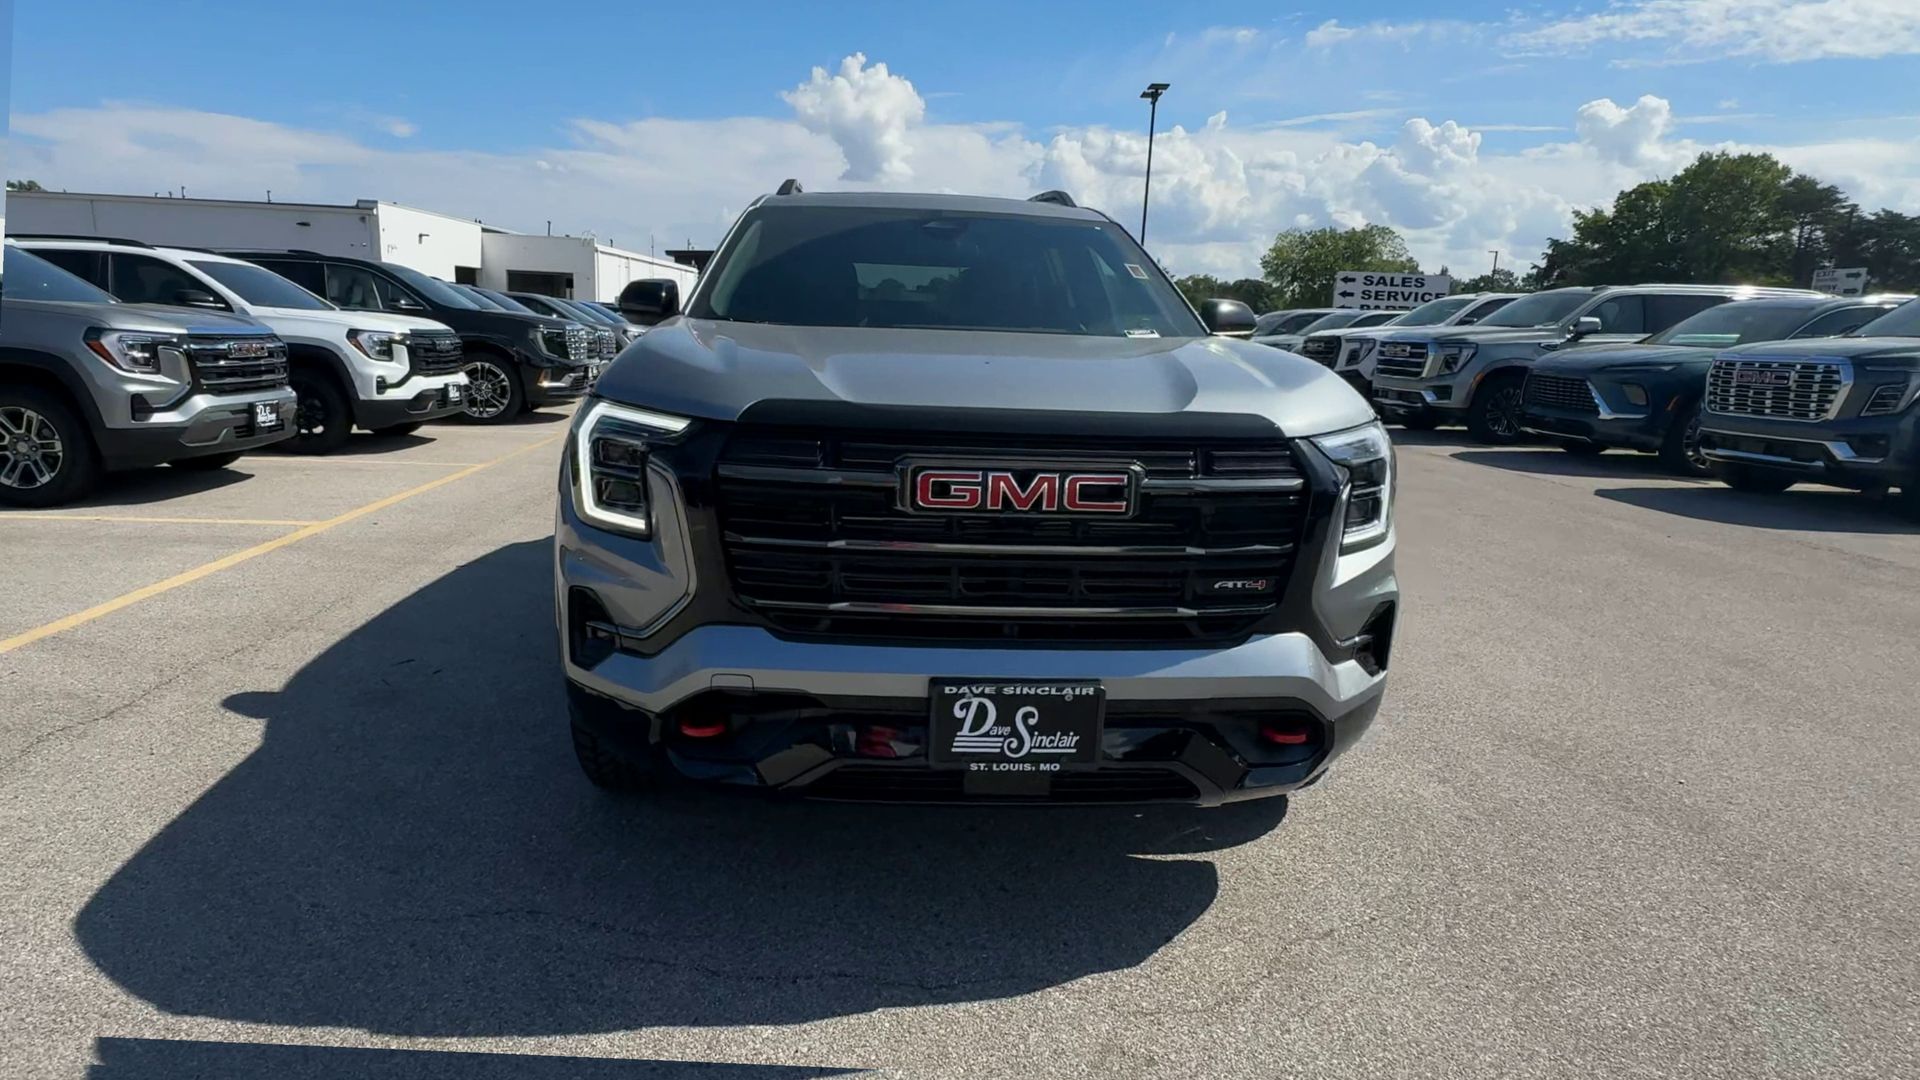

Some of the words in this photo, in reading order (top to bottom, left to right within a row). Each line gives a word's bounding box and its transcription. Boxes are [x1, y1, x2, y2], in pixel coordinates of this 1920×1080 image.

[1363, 275, 1426, 288] SALES
[1737, 371, 1789, 384] GMC
[917, 470, 1128, 513] GMC
[1214, 578, 1266, 591] AT4
[944, 686, 996, 695] DAVE
[1002, 686, 1095, 695] SINCLAIR
[953, 697, 1011, 736] Dave
[1003, 706, 1080, 758] Sinclair
[969, 762, 989, 771] ST.
[992, 762, 1036, 772] LOUIS,
[1039, 762, 1061, 771] MO
